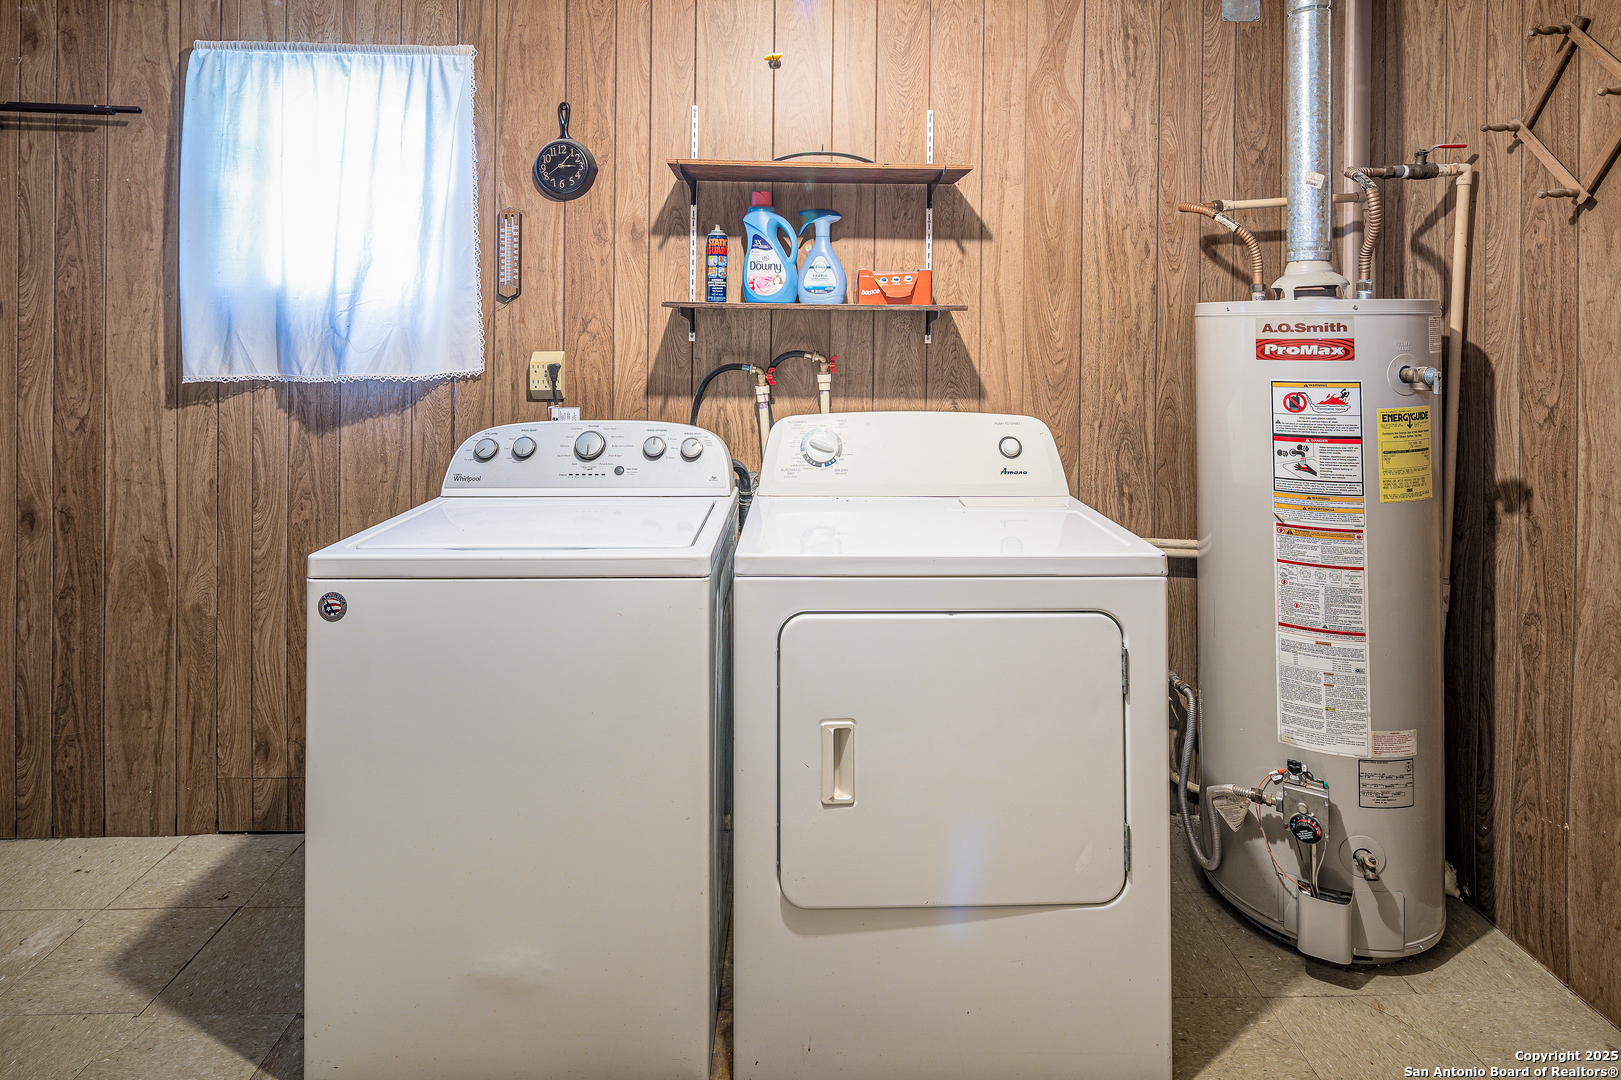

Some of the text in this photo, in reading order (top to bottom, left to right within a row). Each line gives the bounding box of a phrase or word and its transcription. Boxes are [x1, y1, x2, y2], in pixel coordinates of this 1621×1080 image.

[550, 147, 557, 156] 11
[557, 145, 567, 154] 12
[571, 148, 574, 157] 1
[542, 153, 551, 163] 10
[575, 154, 581, 163] 2
[540, 164, 546, 173] 9
[578, 162, 584, 171] 3
[543, 172, 549, 180] 8
[575, 170, 581, 179] 4
[550, 178, 556, 187] 7
[559, 179, 565, 188] 6
[569, 176, 575, 186] 5
[708, 238, 727, 246] STATIC
[750, 261, 782, 274] Downy
[1261, 322, 1348, 333] A.O.Smith
[1264, 344, 1344, 355] ProMax
[1000, 467, 1028, 475] Amana
[453, 475, 482, 483] Whirlpool
